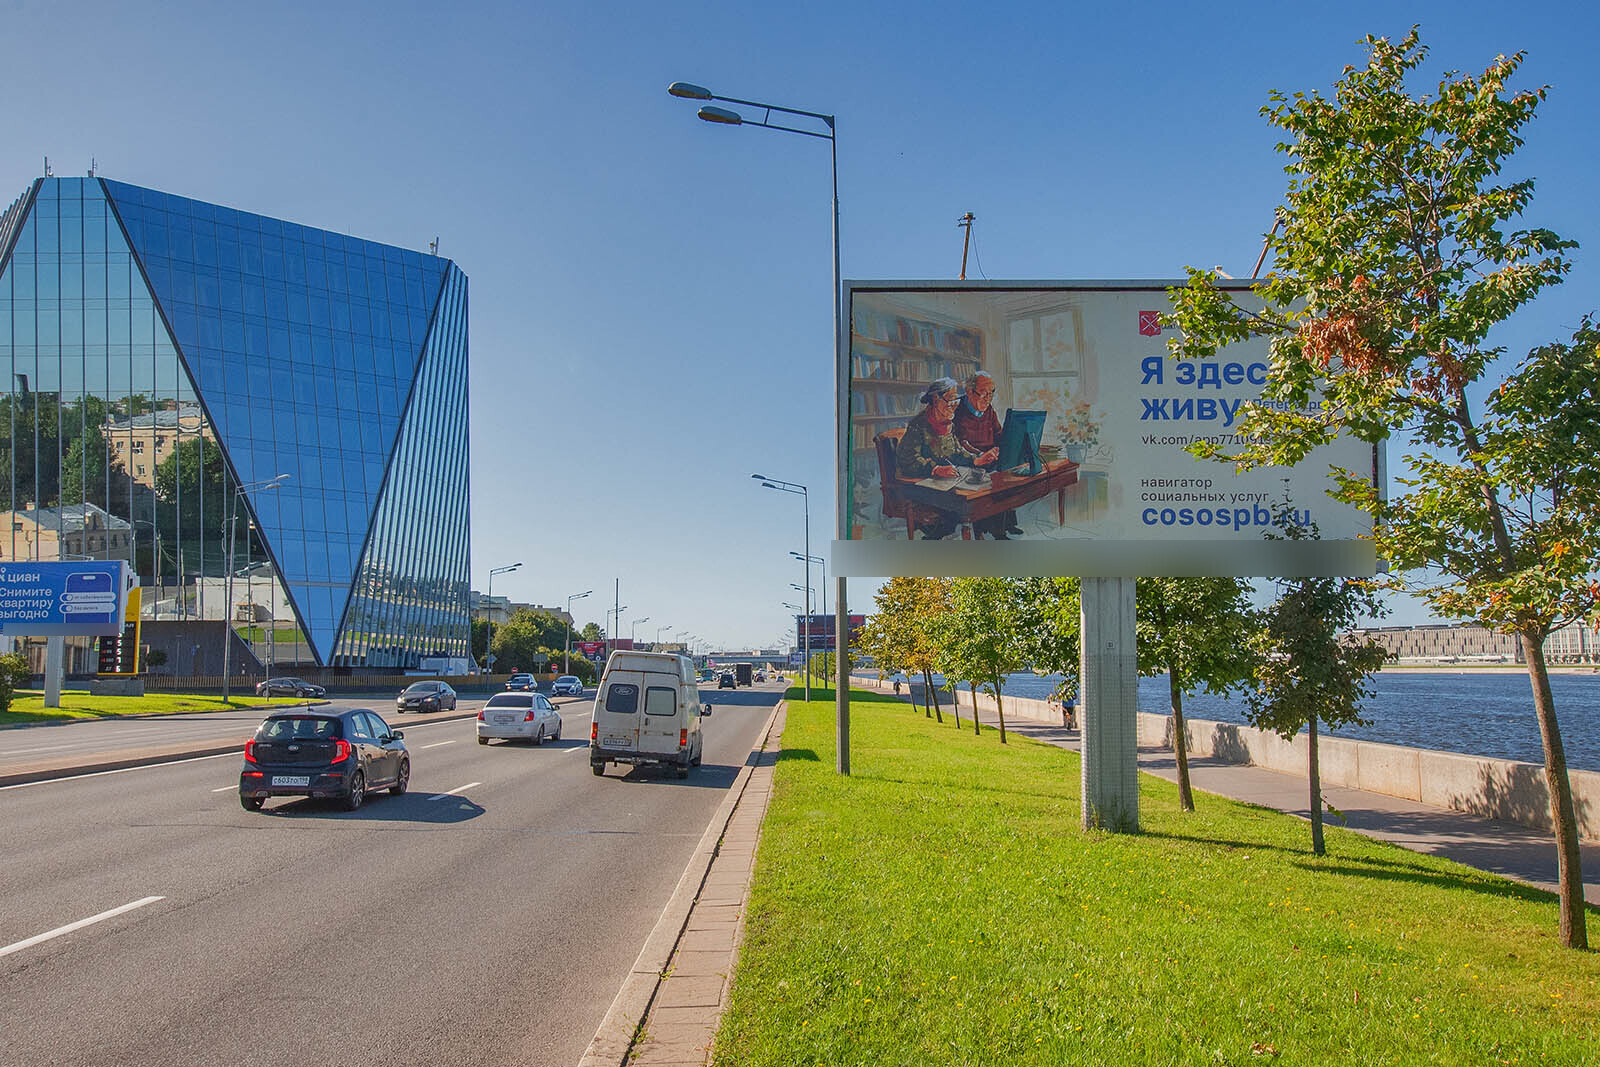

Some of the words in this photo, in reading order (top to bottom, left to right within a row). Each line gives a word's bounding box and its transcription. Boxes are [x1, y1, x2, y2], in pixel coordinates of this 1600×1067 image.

[1140, 356, 1163, 385] Я
[1175, 362, 1272, 390] здес
[1140, 398, 1242, 428] живу
[1141, 477, 1213, 489] навигатор
[1140, 492, 1226, 503] социальных
[1230, 493, 1270, 505] услуг
[1141, 503, 1311, 532] cosospb.ru
[8, 573, 40, 583] циан
[0, 587, 53, 597] Снимите
